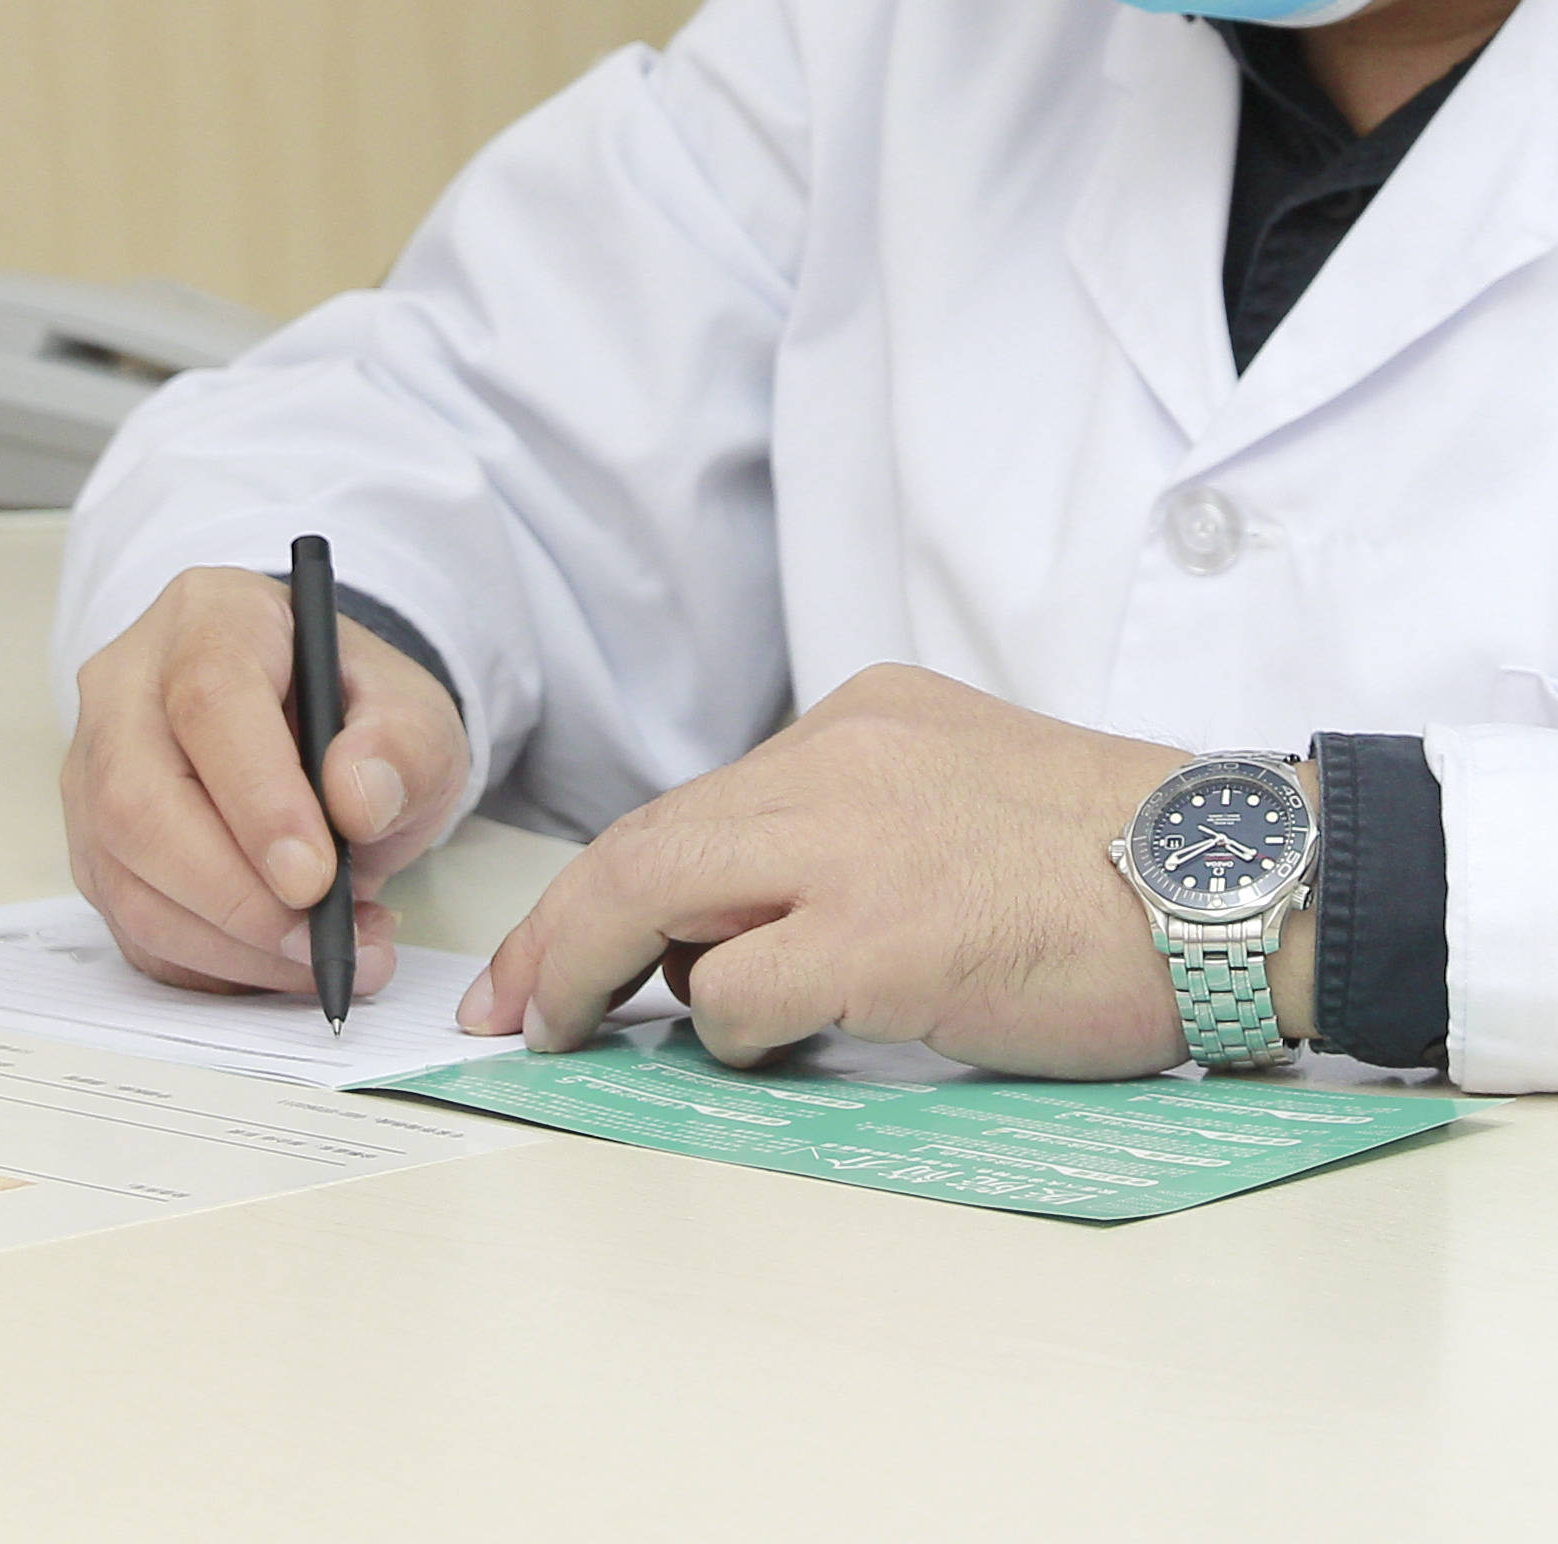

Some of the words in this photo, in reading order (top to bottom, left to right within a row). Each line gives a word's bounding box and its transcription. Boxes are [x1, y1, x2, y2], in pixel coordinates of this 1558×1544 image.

[1282, 785, 1302, 810] 40
[1204, 860, 1235, 868] OMEGA
[1277, 852, 1302, 878] 50
[824, 1155, 1099, 1206] 医院简介
